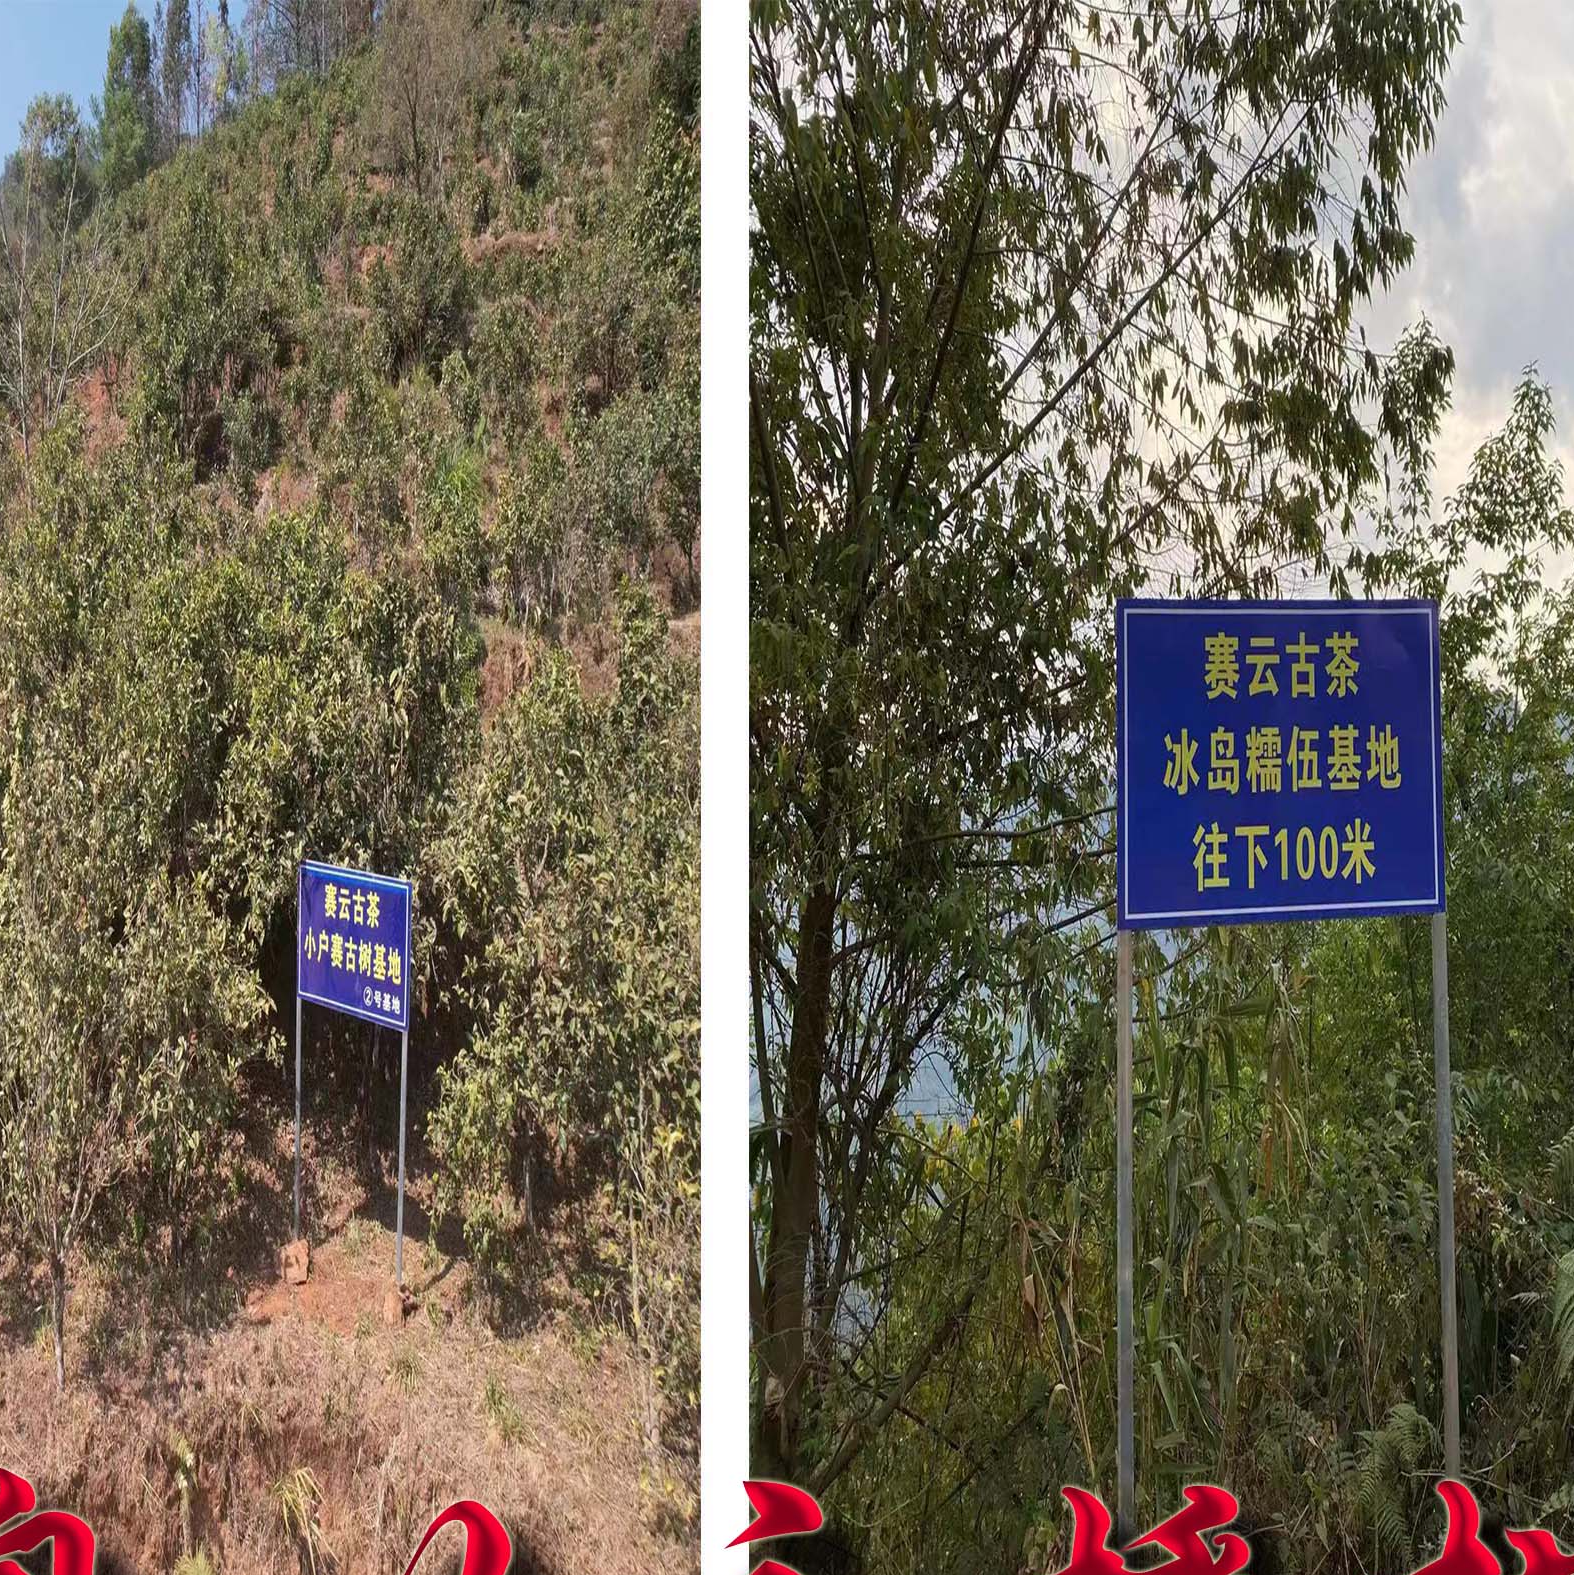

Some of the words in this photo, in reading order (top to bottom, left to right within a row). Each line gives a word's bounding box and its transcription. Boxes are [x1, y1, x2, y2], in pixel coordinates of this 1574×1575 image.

[1204, 632, 1360, 699] 赛云古茶
[1162, 724, 1402, 795] 冰岛糯伍基地
[1192, 818, 1376, 892] 往下100米
[325, 883, 380, 928] 赛云古茶
[304, 926, 401, 985] 小户赛古树基地
